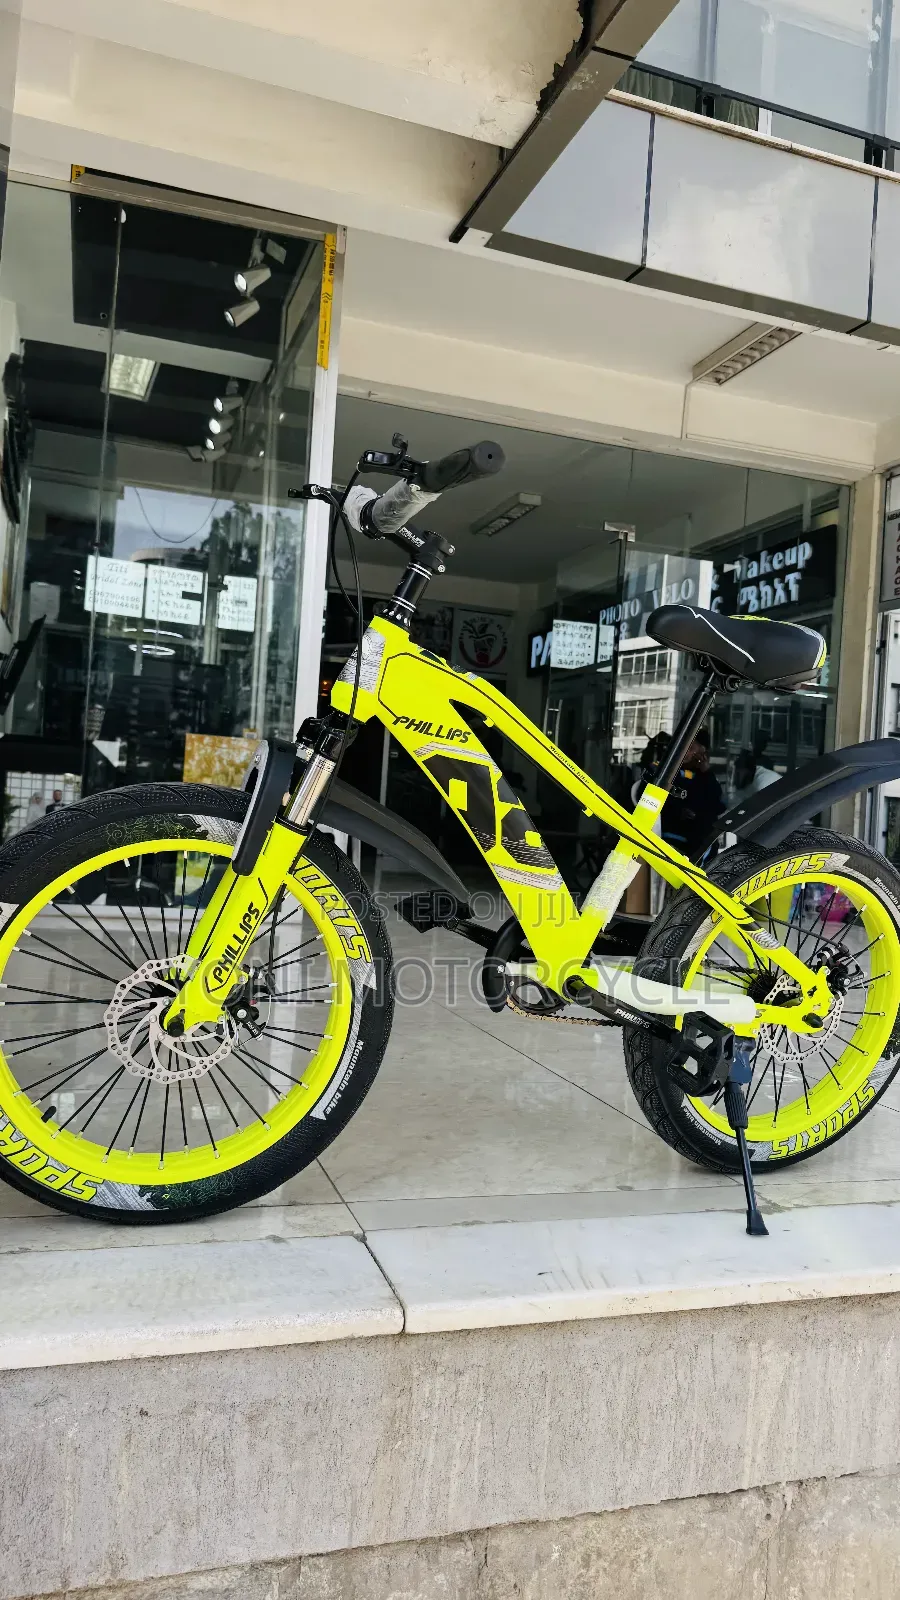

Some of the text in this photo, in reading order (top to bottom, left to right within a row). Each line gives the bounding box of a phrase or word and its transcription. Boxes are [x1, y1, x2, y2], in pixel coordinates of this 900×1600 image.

[600, 598, 641, 625] PHOTO
[733, 541, 814, 583] Makeup
[392, 715, 472, 744] PHILLIPS
[212, 902, 260, 984] PHILLIPS
[325, 1039, 365, 1115] Mountain bike
[767, 1079, 876, 1161] SPORTS
